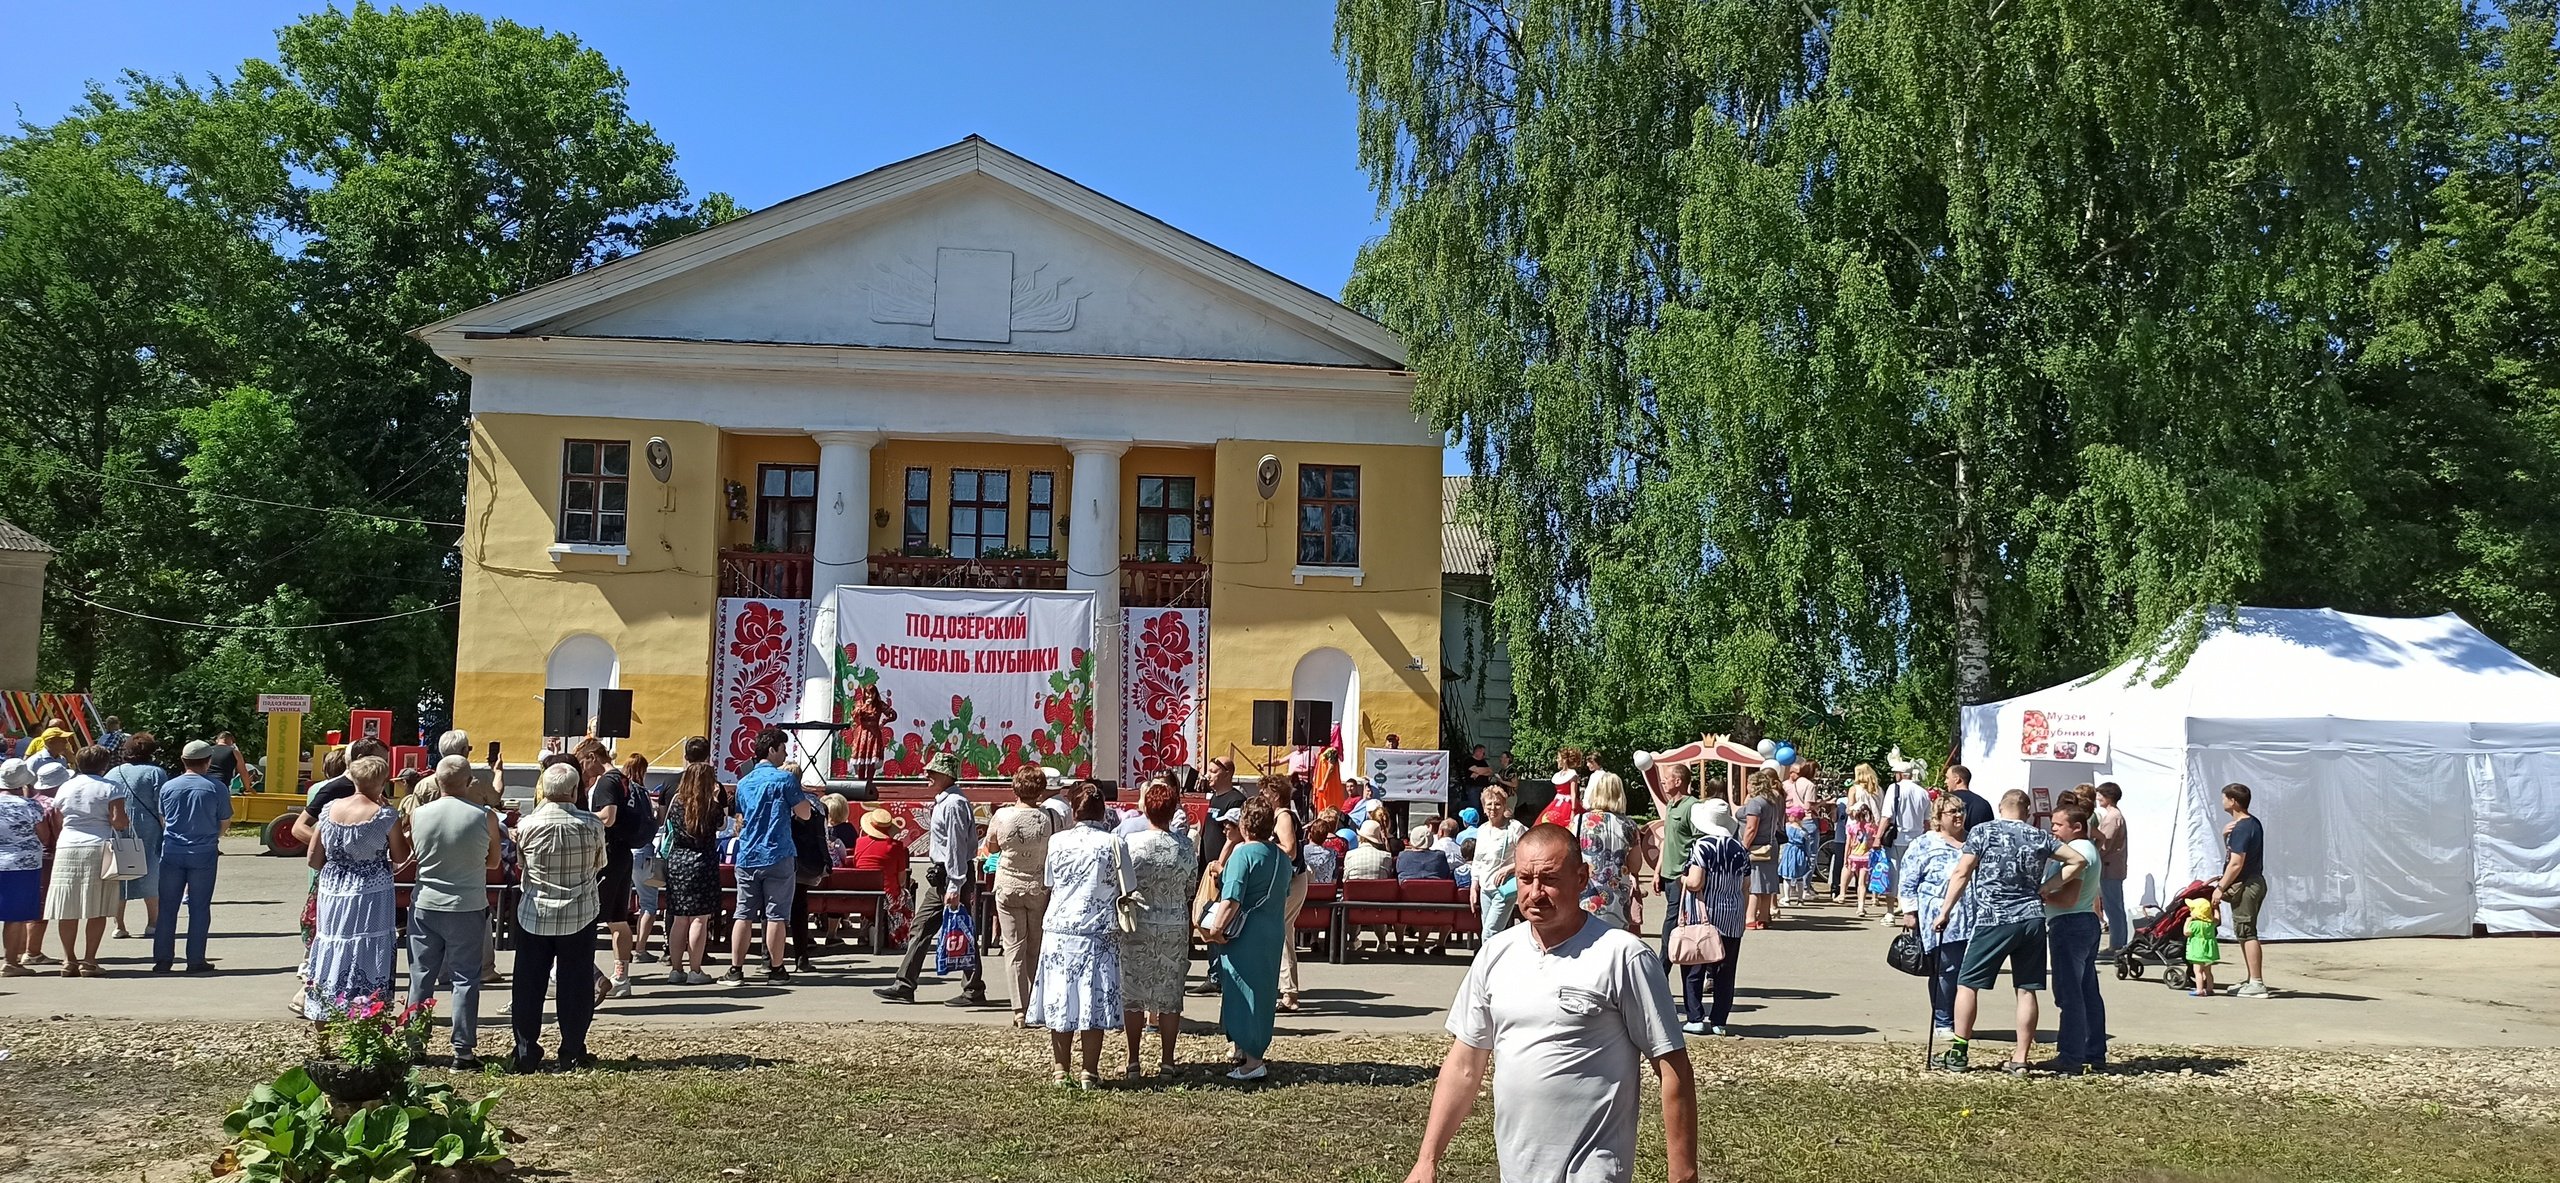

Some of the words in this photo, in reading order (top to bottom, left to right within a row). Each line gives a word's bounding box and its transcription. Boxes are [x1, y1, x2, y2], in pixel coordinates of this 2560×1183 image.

[906, 612, 1027, 642] ПОДОЗЁРСКИЙ
[876, 643, 970, 674] ФЕСТИВАЛЬ
[974, 647, 1059, 674] КЛУБНИКИ
[2035, 728, 2095, 738] клубники
[946, 934, 964, 952] GJ
